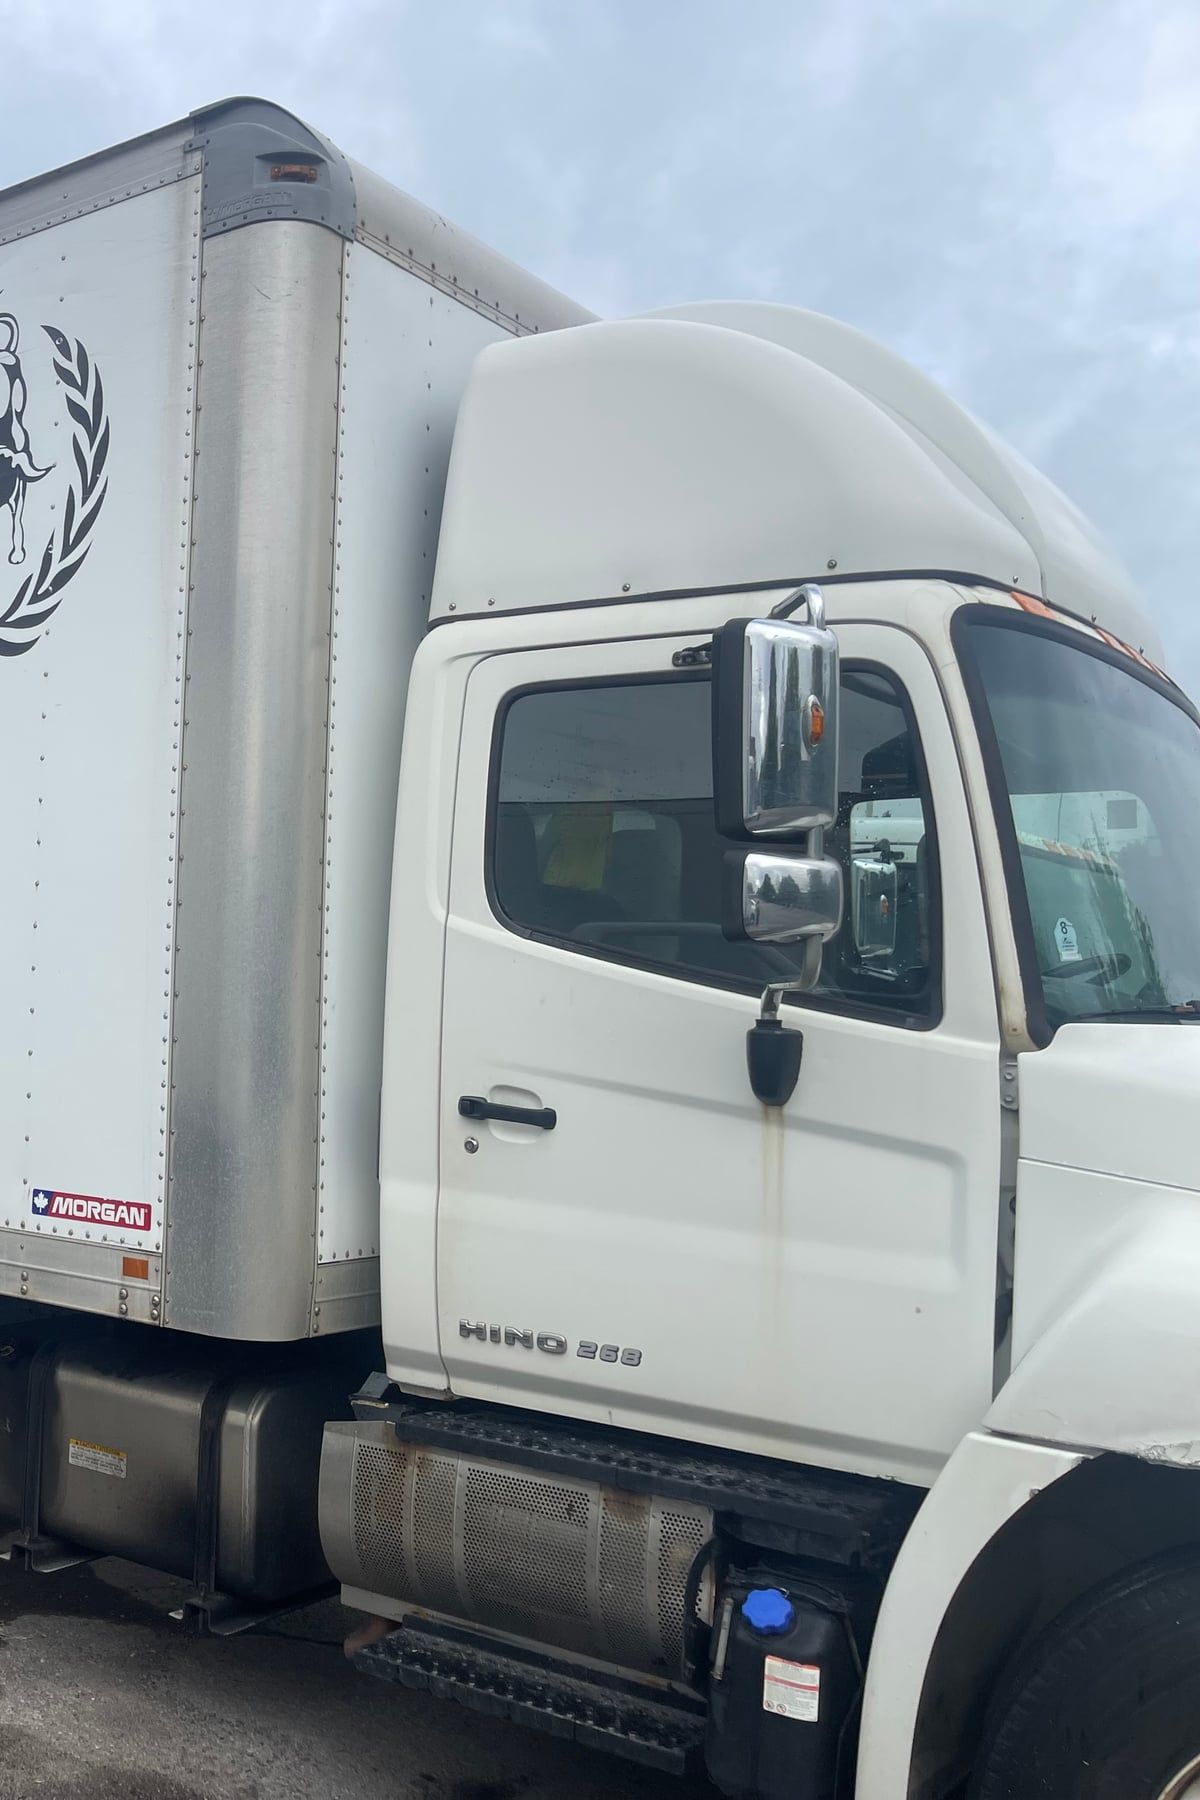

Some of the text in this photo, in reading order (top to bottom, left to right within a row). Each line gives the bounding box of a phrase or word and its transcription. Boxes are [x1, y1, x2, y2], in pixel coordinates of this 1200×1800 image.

[51, 1196, 145, 1227] MORGAN
[459, 1319, 642, 1367] HINO 268
